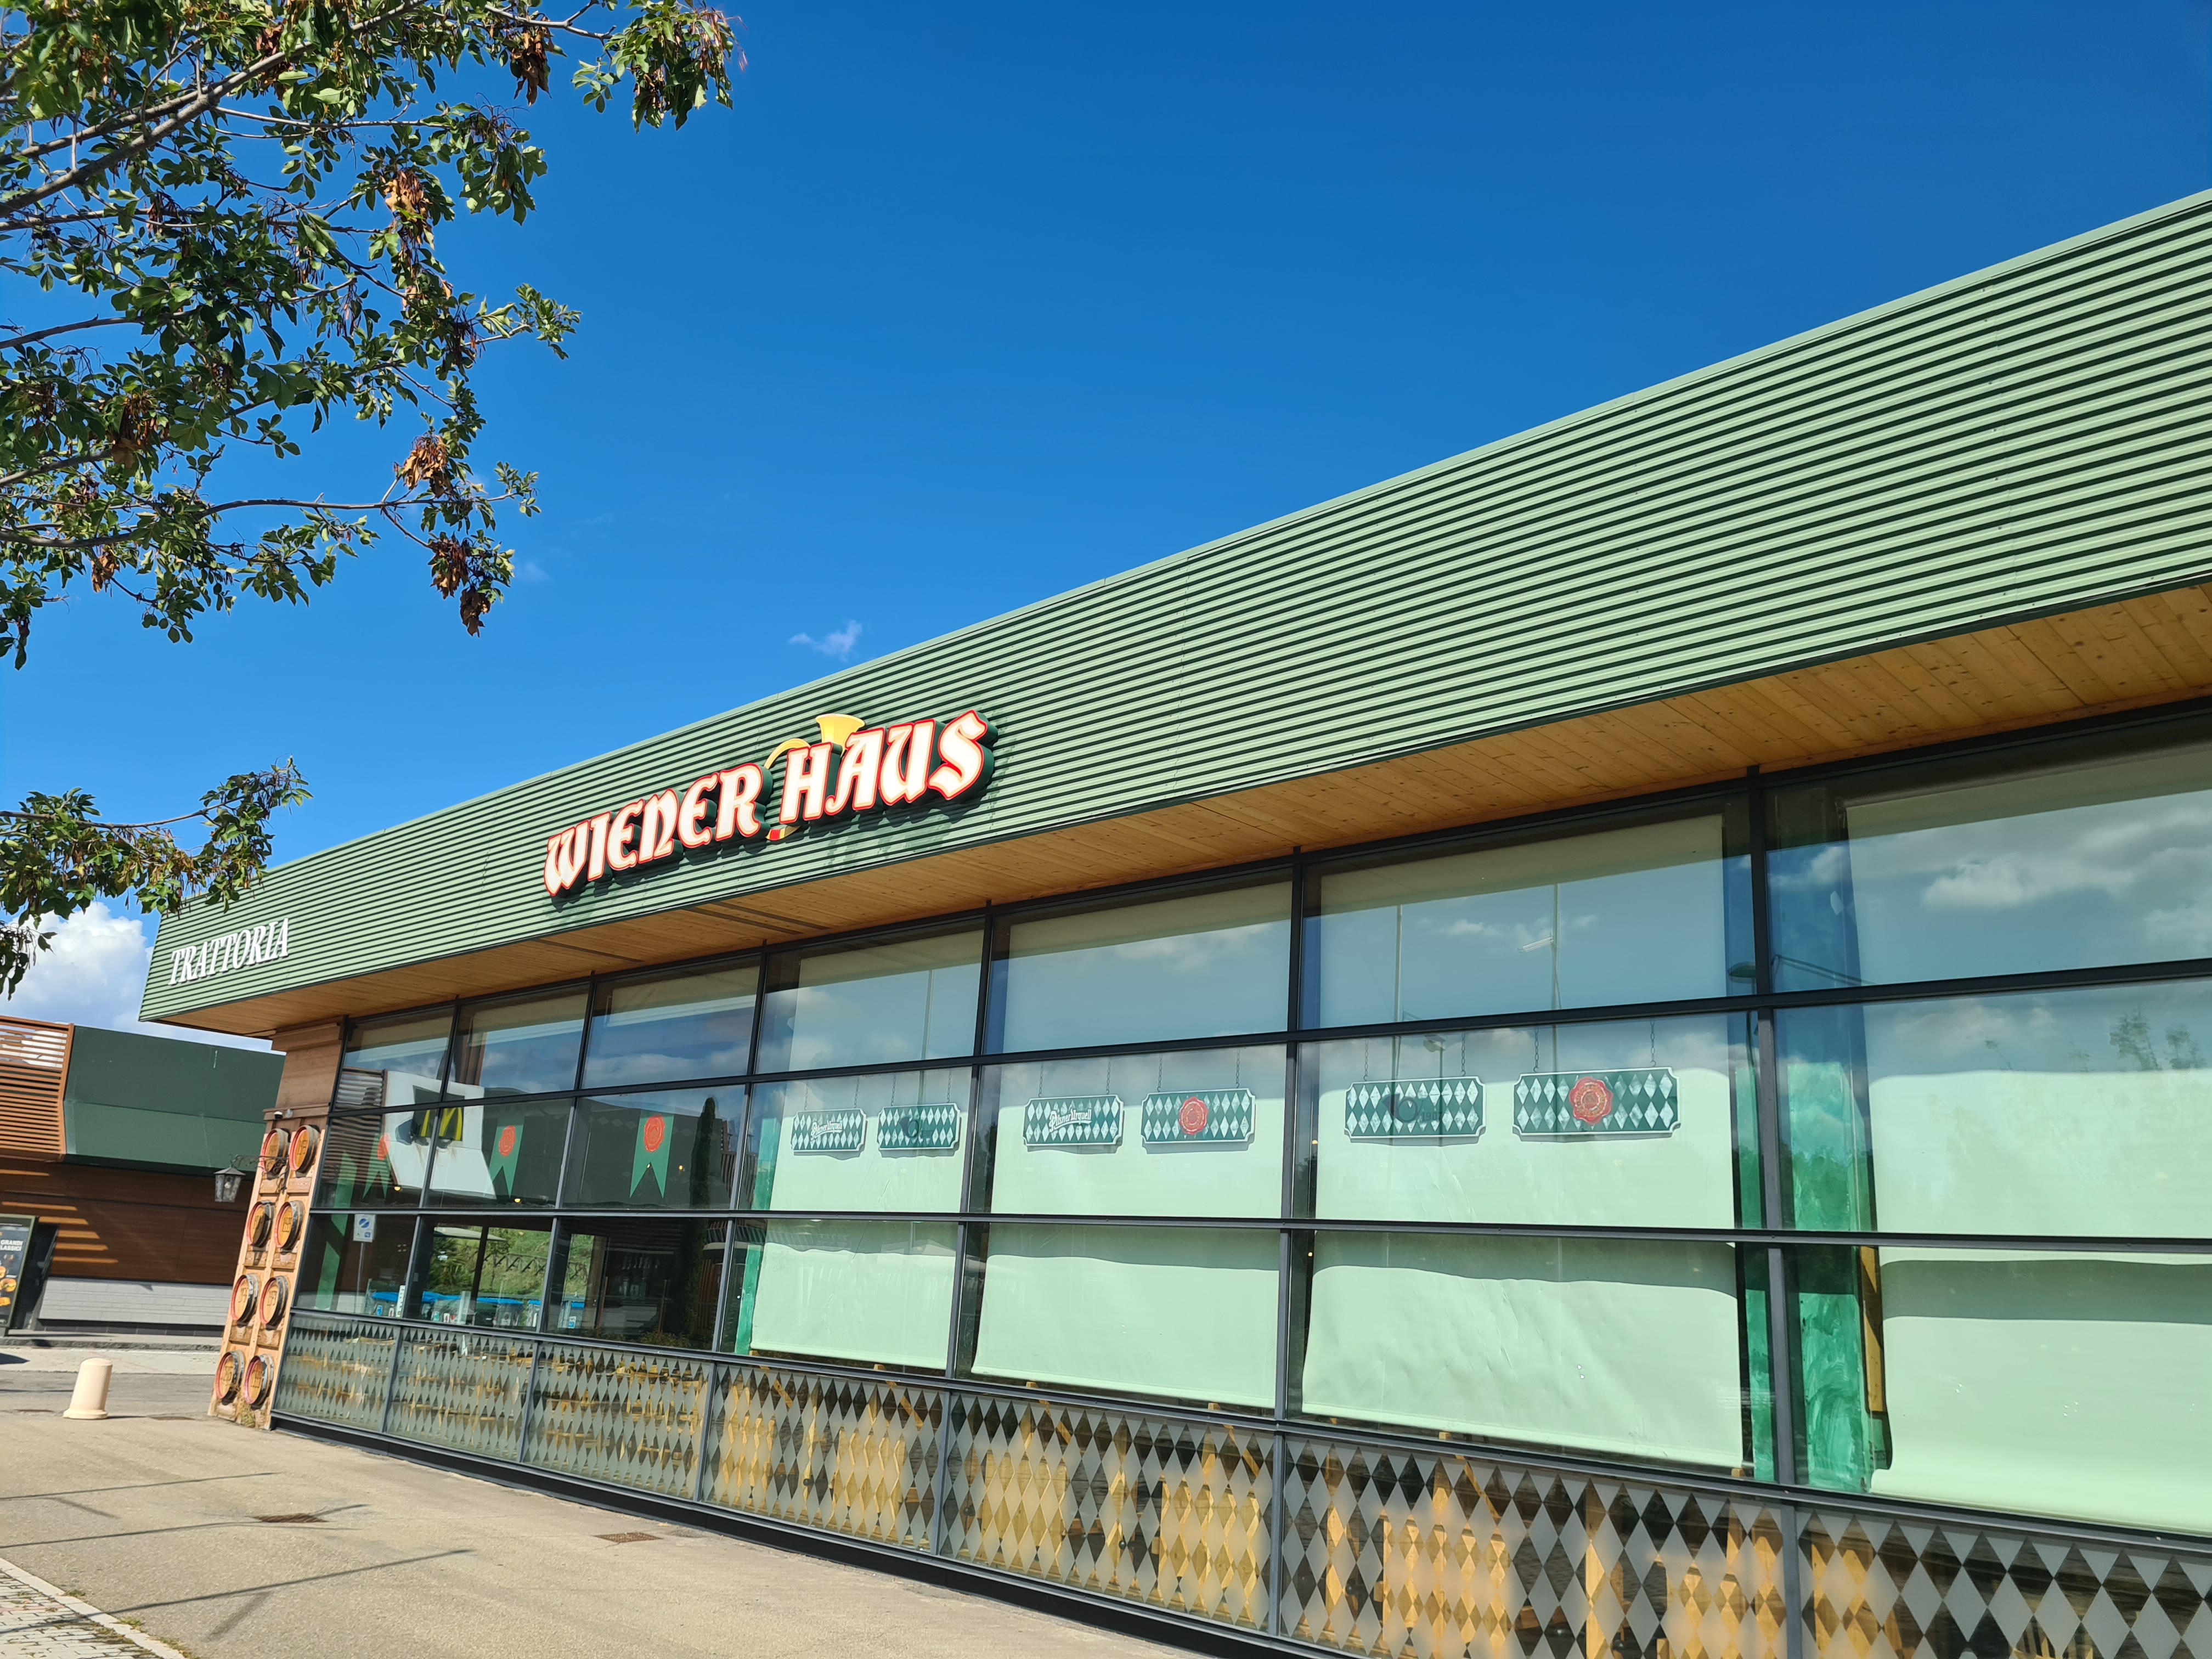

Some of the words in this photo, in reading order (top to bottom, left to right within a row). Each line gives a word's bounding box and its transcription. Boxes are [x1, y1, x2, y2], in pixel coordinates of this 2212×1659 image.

[543, 763, 768, 896] WIENER
[779, 709, 989, 824] HAUS
[167, 918, 289, 986] TRATTORIA
[1049, 1110, 1071, 1132] Pilsner
[1070, 1109, 1092, 1124] Urquell
[1421, 1111, 1442, 1121] 1907
